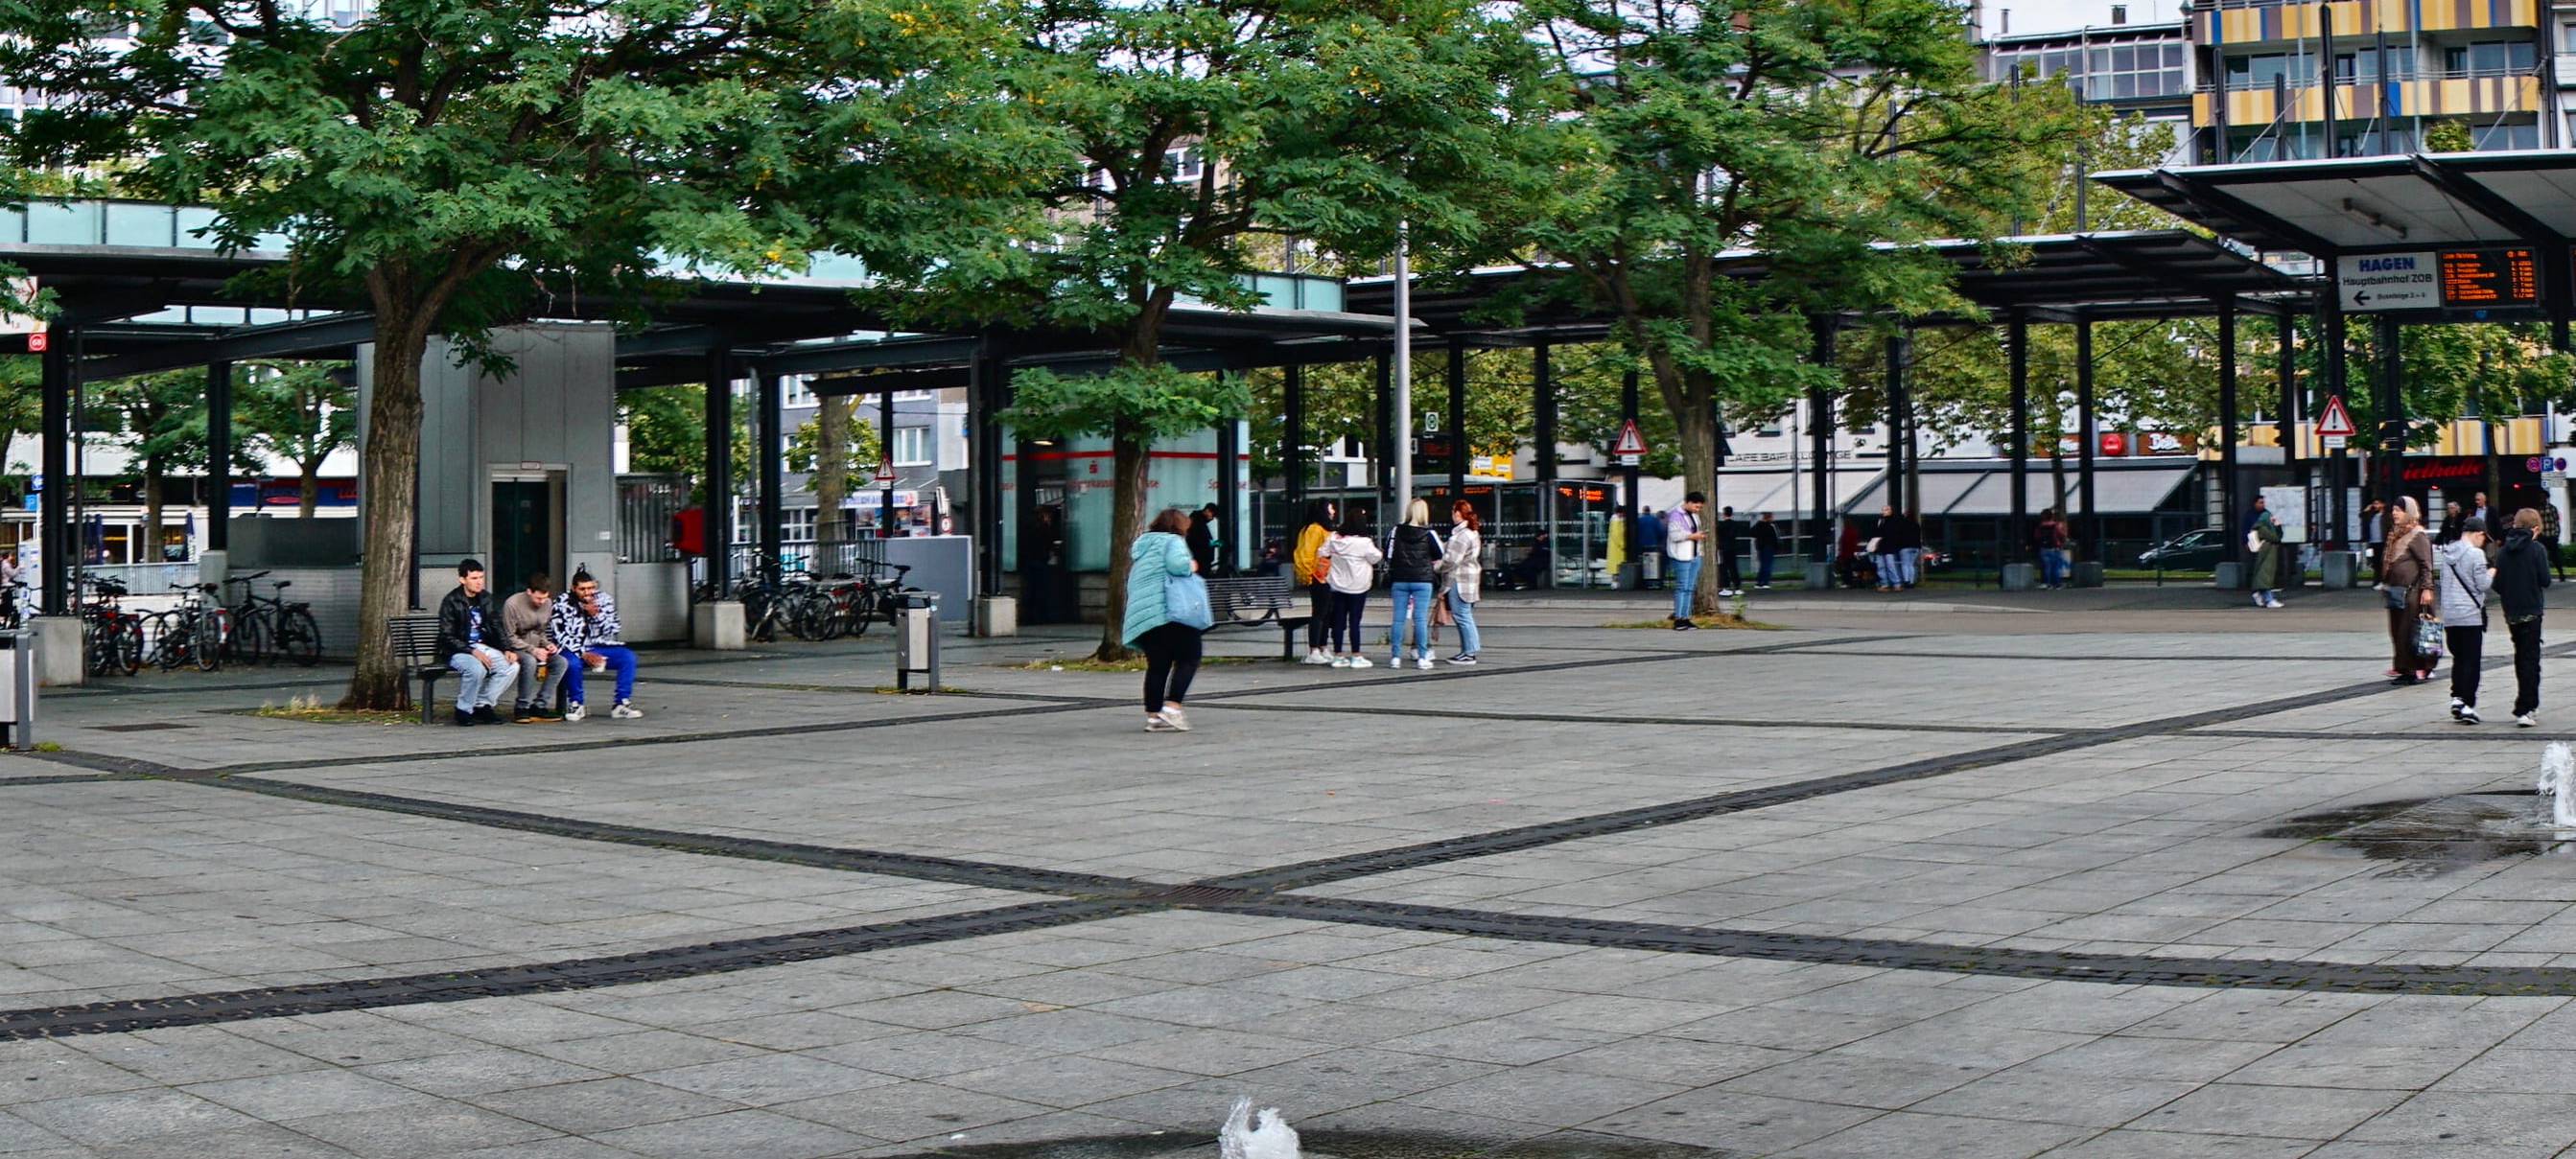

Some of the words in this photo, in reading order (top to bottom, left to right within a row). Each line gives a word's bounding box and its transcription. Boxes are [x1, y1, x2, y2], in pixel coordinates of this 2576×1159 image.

[2359, 256, 2414, 272] HAGEN
[2343, 274, 2409, 287] Hauptbahnhof
[2411, 273, 2432, 283] ZOB
